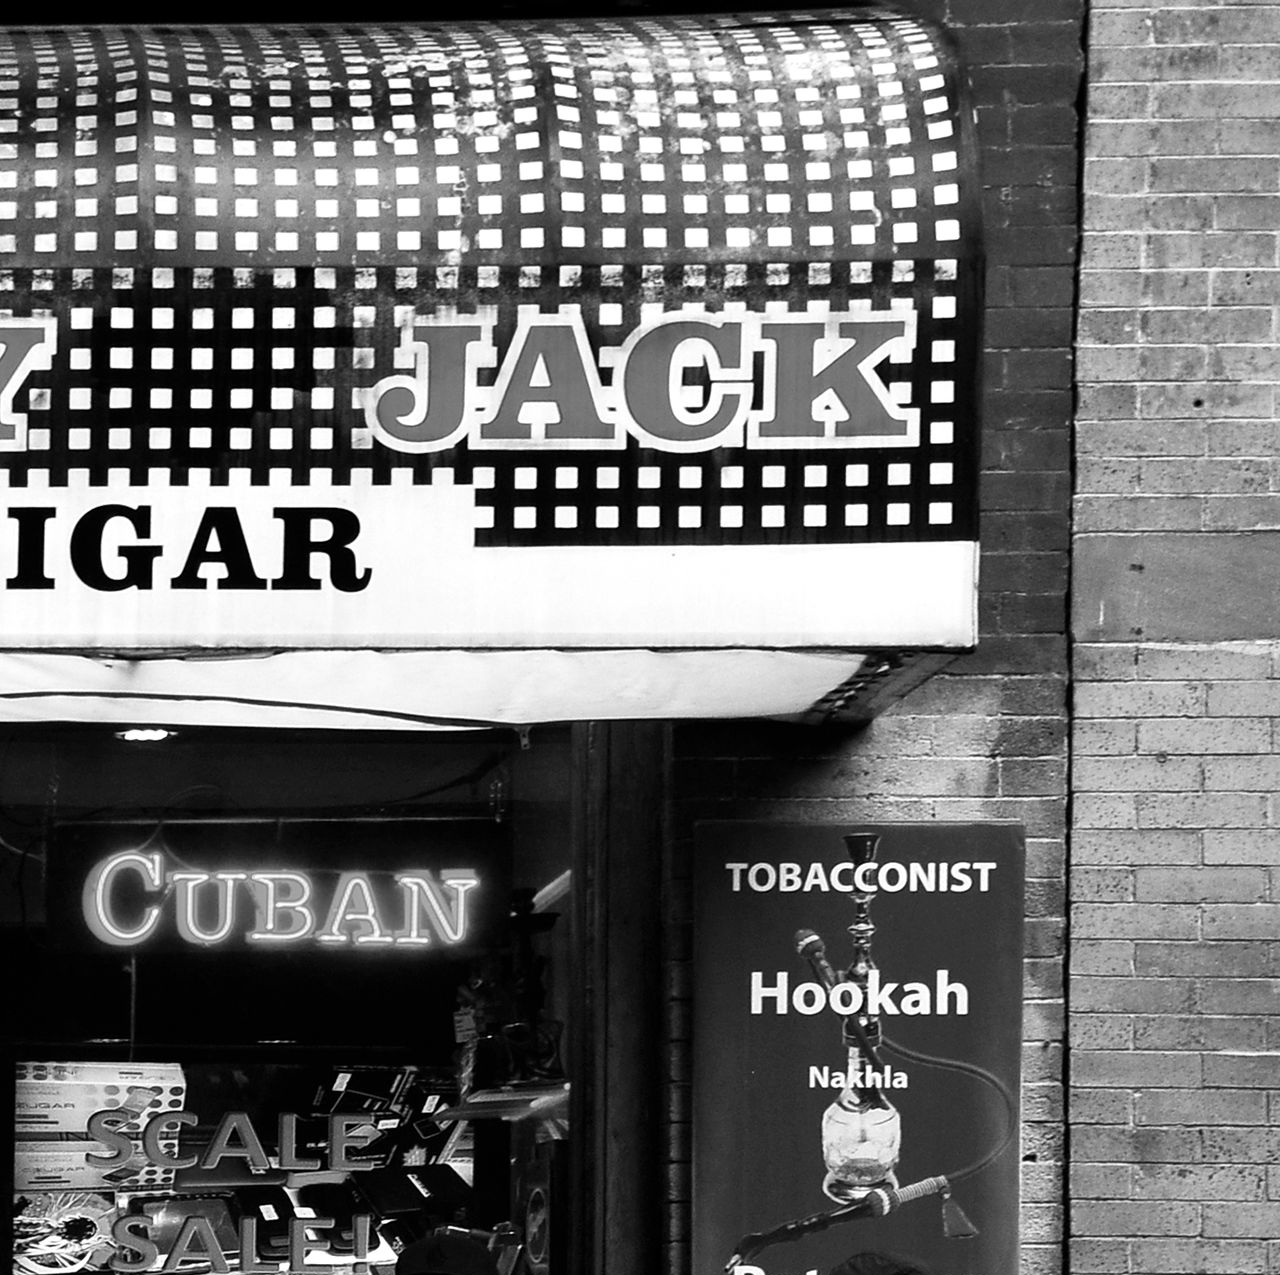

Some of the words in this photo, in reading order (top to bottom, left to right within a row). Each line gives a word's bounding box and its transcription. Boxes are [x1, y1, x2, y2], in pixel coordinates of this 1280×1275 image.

[365, 310, 920, 453] JACK
[81, 849, 480, 946] CUBAN
[725, 861, 997, 893] TOBACCONIST
[750, 969, 969, 1016] Hookah
[808, 1065, 909, 1090] Nakhla
[84, 1109, 378, 1173] SCALE
[108, 1213, 372, 1275] SALE!
